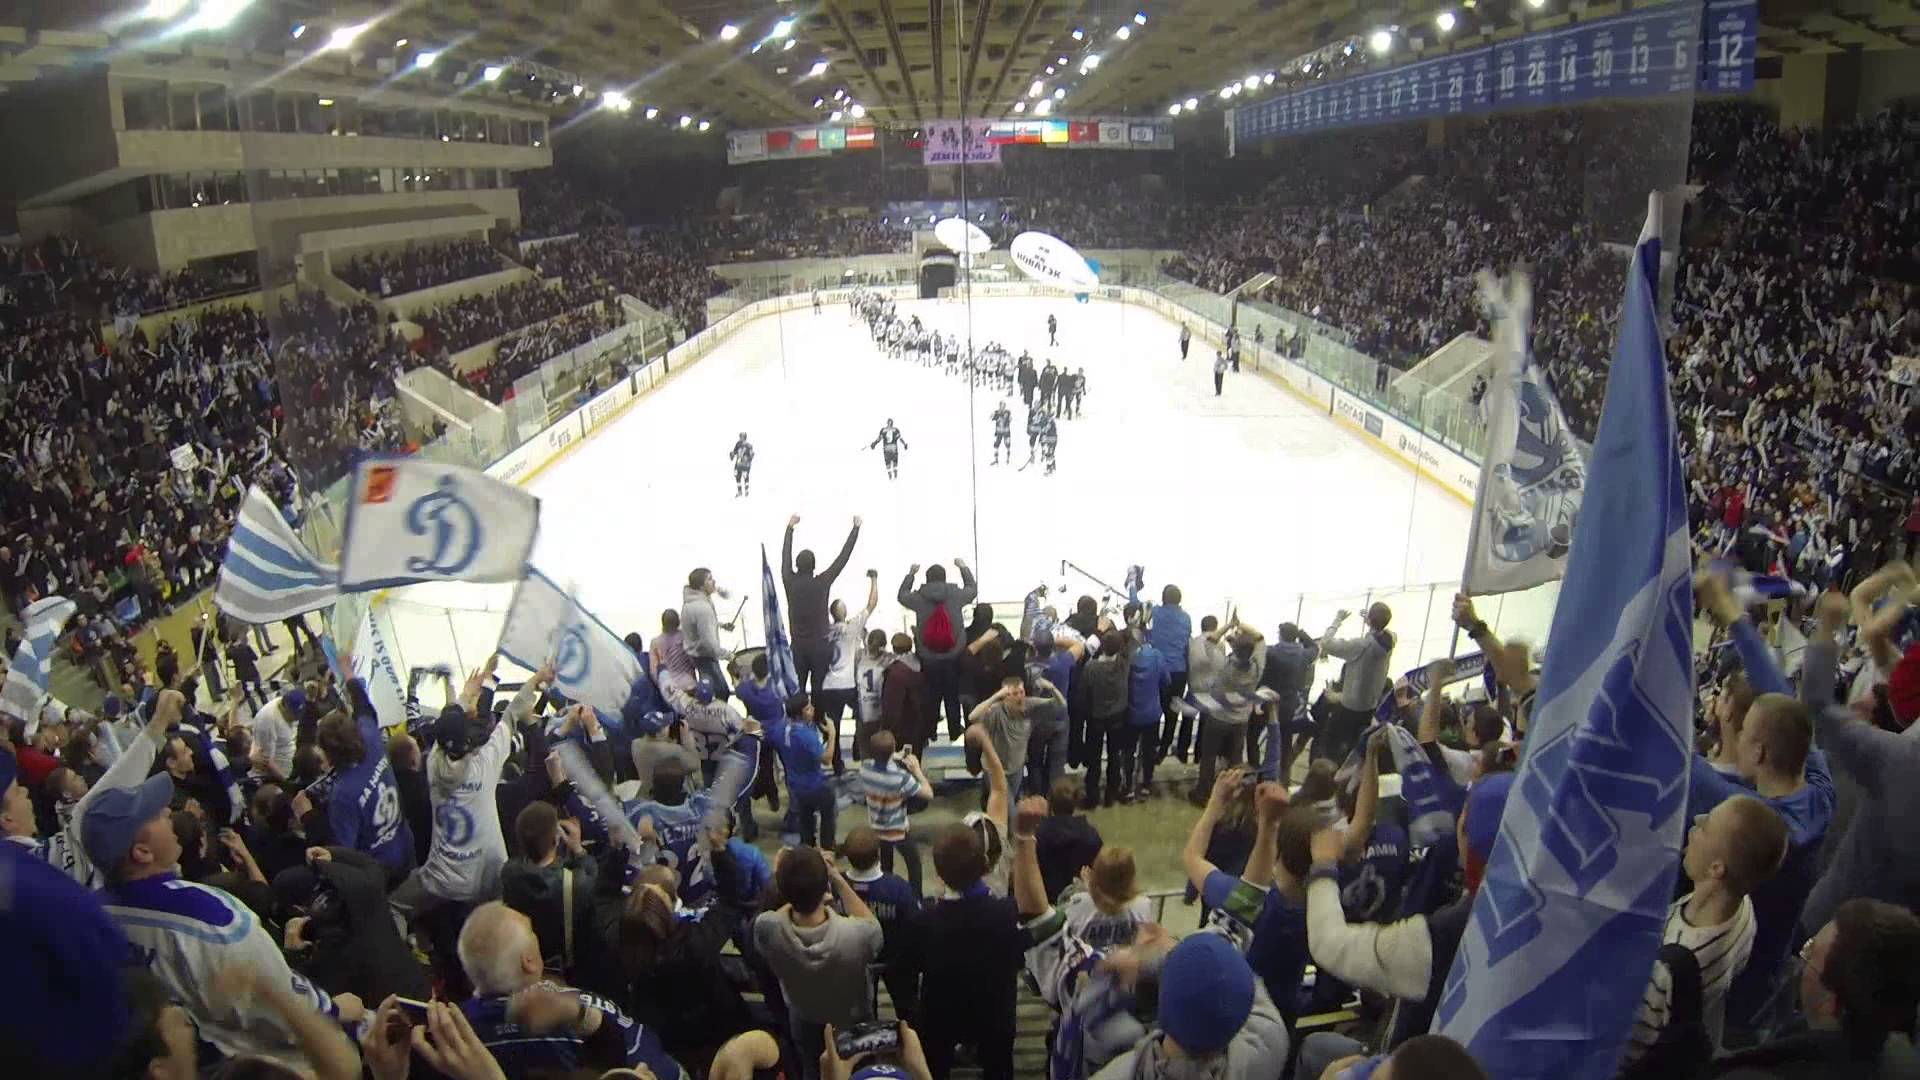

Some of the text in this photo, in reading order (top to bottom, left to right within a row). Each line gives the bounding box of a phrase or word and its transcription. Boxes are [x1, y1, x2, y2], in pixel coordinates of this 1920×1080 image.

[1592, 49, 1613, 78] 30
[1630, 45, 1649, 74] 13
[1675, 40, 1687, 70] 6
[1717, 34, 1743, 67] 12
[1501, 66, 1515, 91] 10
[1528, 61, 1546, 87] 26
[1559, 55, 1577, 83] 14
